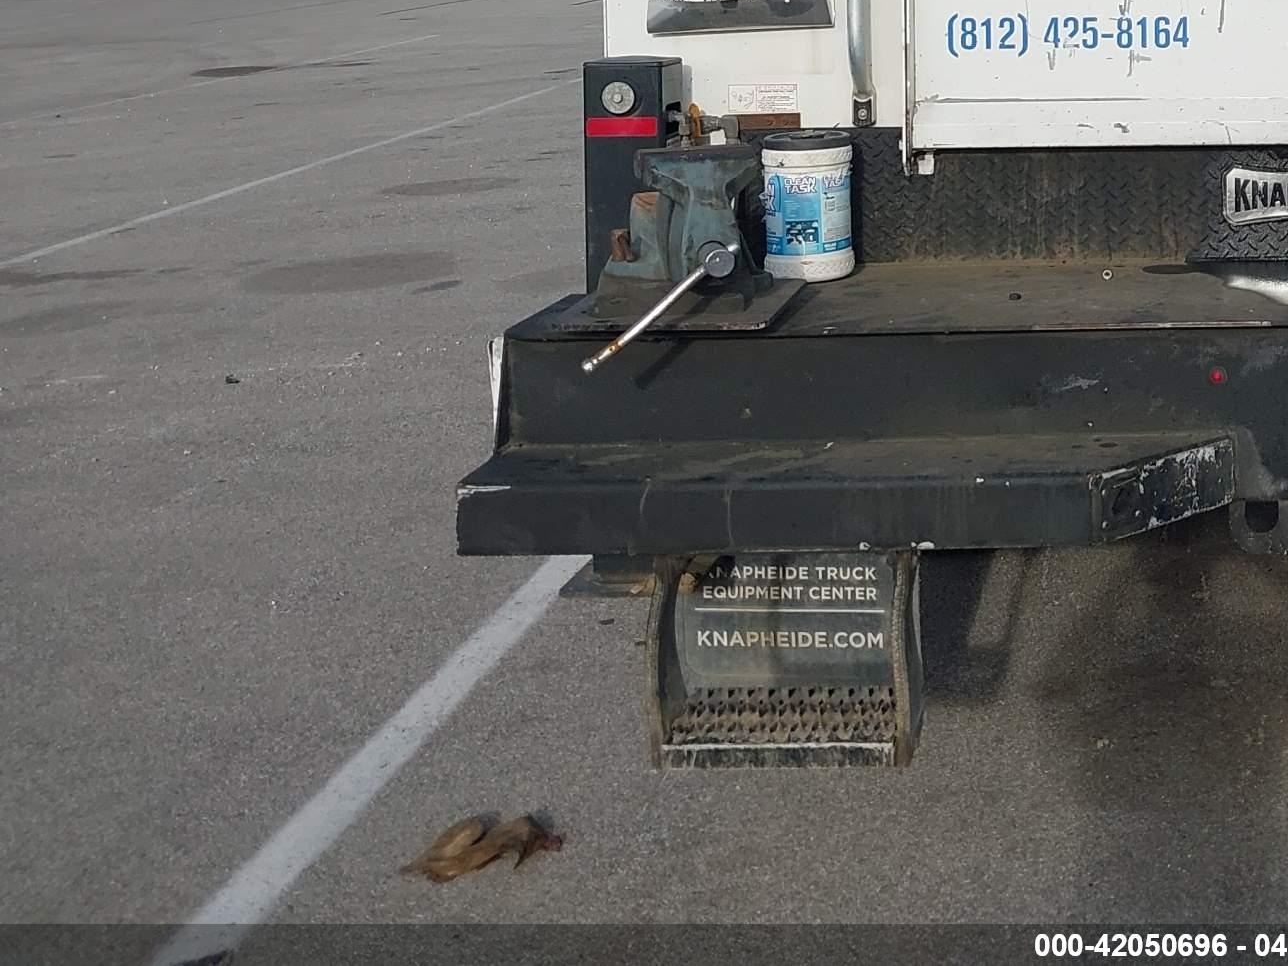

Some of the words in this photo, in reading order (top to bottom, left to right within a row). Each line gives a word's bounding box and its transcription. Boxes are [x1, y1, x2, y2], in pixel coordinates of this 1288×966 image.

[947, 13, 1029, 58] (812)
[1043, 16, 1189, 50] 425-8164
[784, 177, 816, 186] CLEAN
[784, 185, 818, 194] TASK
[705, 566, 808, 580] NAPHEIDE
[816, 566, 877, 580] TRUCK
[703, 586, 804, 601] EQUIPMENT
[809, 586, 877, 601] CENTER
[697, 630, 884, 649] KNAPHEIDE.COM
